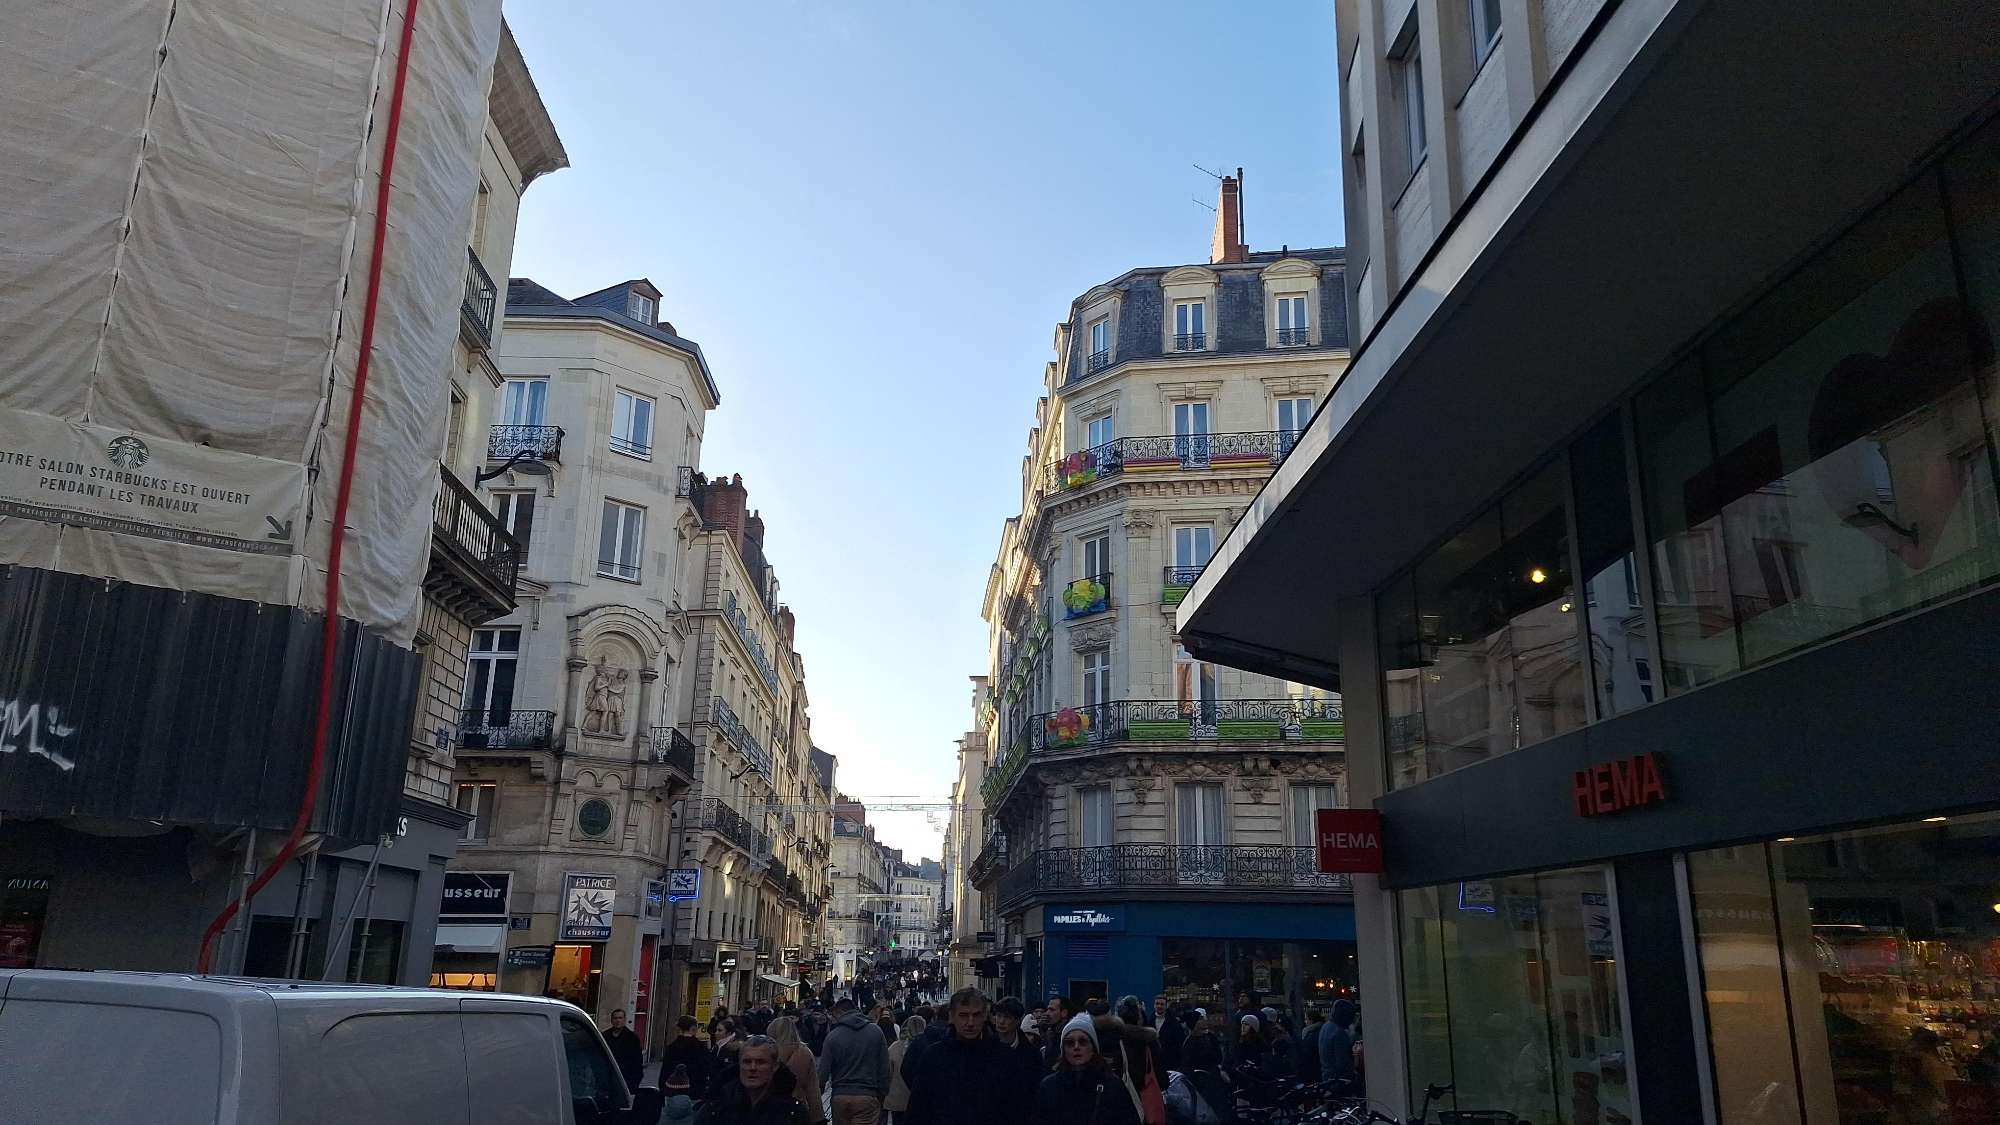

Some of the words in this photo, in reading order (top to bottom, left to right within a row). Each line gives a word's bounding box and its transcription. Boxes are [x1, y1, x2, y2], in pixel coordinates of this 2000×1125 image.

[39, 457, 84, 476] SALON
[89, 467, 168, 491] STARBUCKS
[173, 482, 196, 497] EST
[202, 486, 251, 505] OUVERT
[40, 476, 105, 499] PENDANT
[110, 488, 133, 504] LES
[140, 493, 200, 515] TRAVAUX
[1573, 751, 1665, 818] HEMA
[1322, 832, 1378, 849] HEMA
[575, 877, 612, 889] PATRICE
[444, 888, 502, 898] usseur
[567, 928, 610, 937] chausseur
